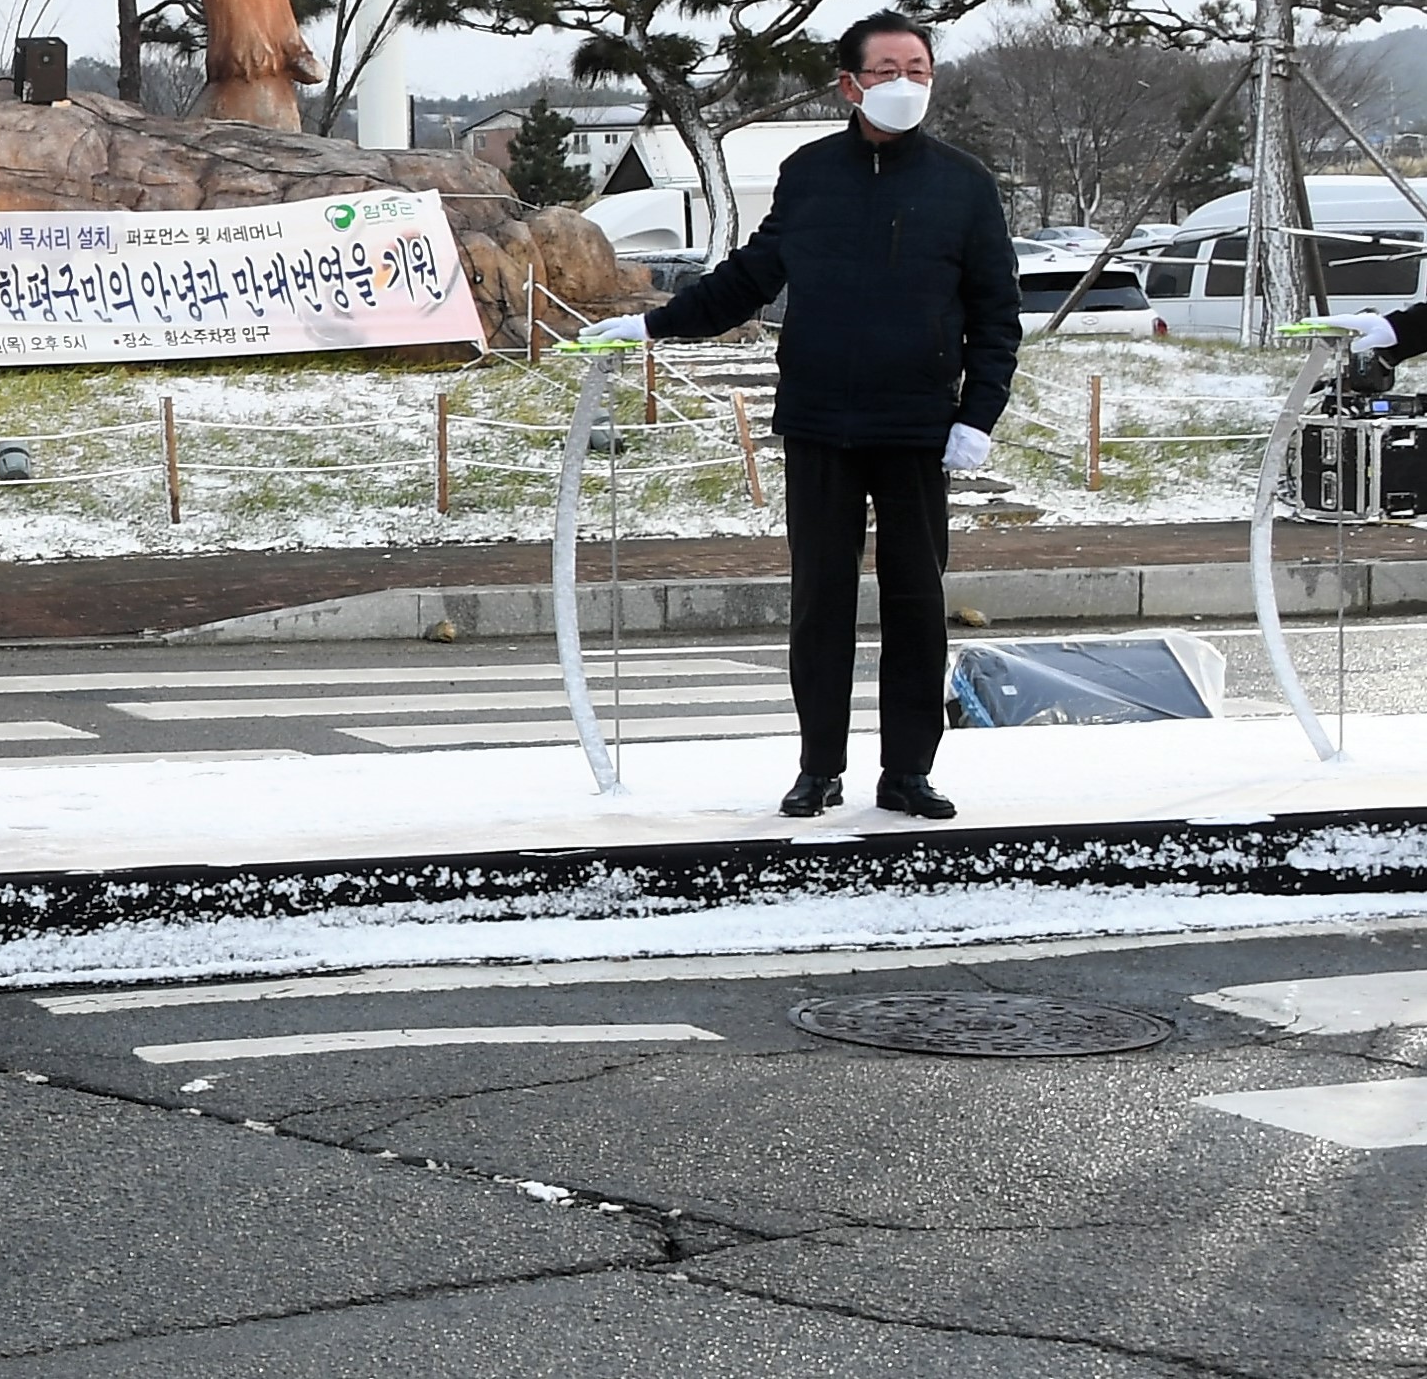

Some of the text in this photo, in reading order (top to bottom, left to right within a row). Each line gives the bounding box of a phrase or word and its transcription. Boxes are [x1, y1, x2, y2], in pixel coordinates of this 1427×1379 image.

[18, 226, 71, 251] 목서리
[126, 226, 190, 248] 퍼포먼스
[196, 226, 211, 246] 및
[216, 221, 284, 244] 세레머니
[141, 259, 229, 323] 안녕과
[232, 242, 377, 318] 만대번영을
[383, 234, 443, 302] 기원
[31, 335, 59, 351] 오후
[63, 333, 88, 350] 5시
[163, 327, 237, 347] 황소주차장
[242, 324, 272, 344] 입구
